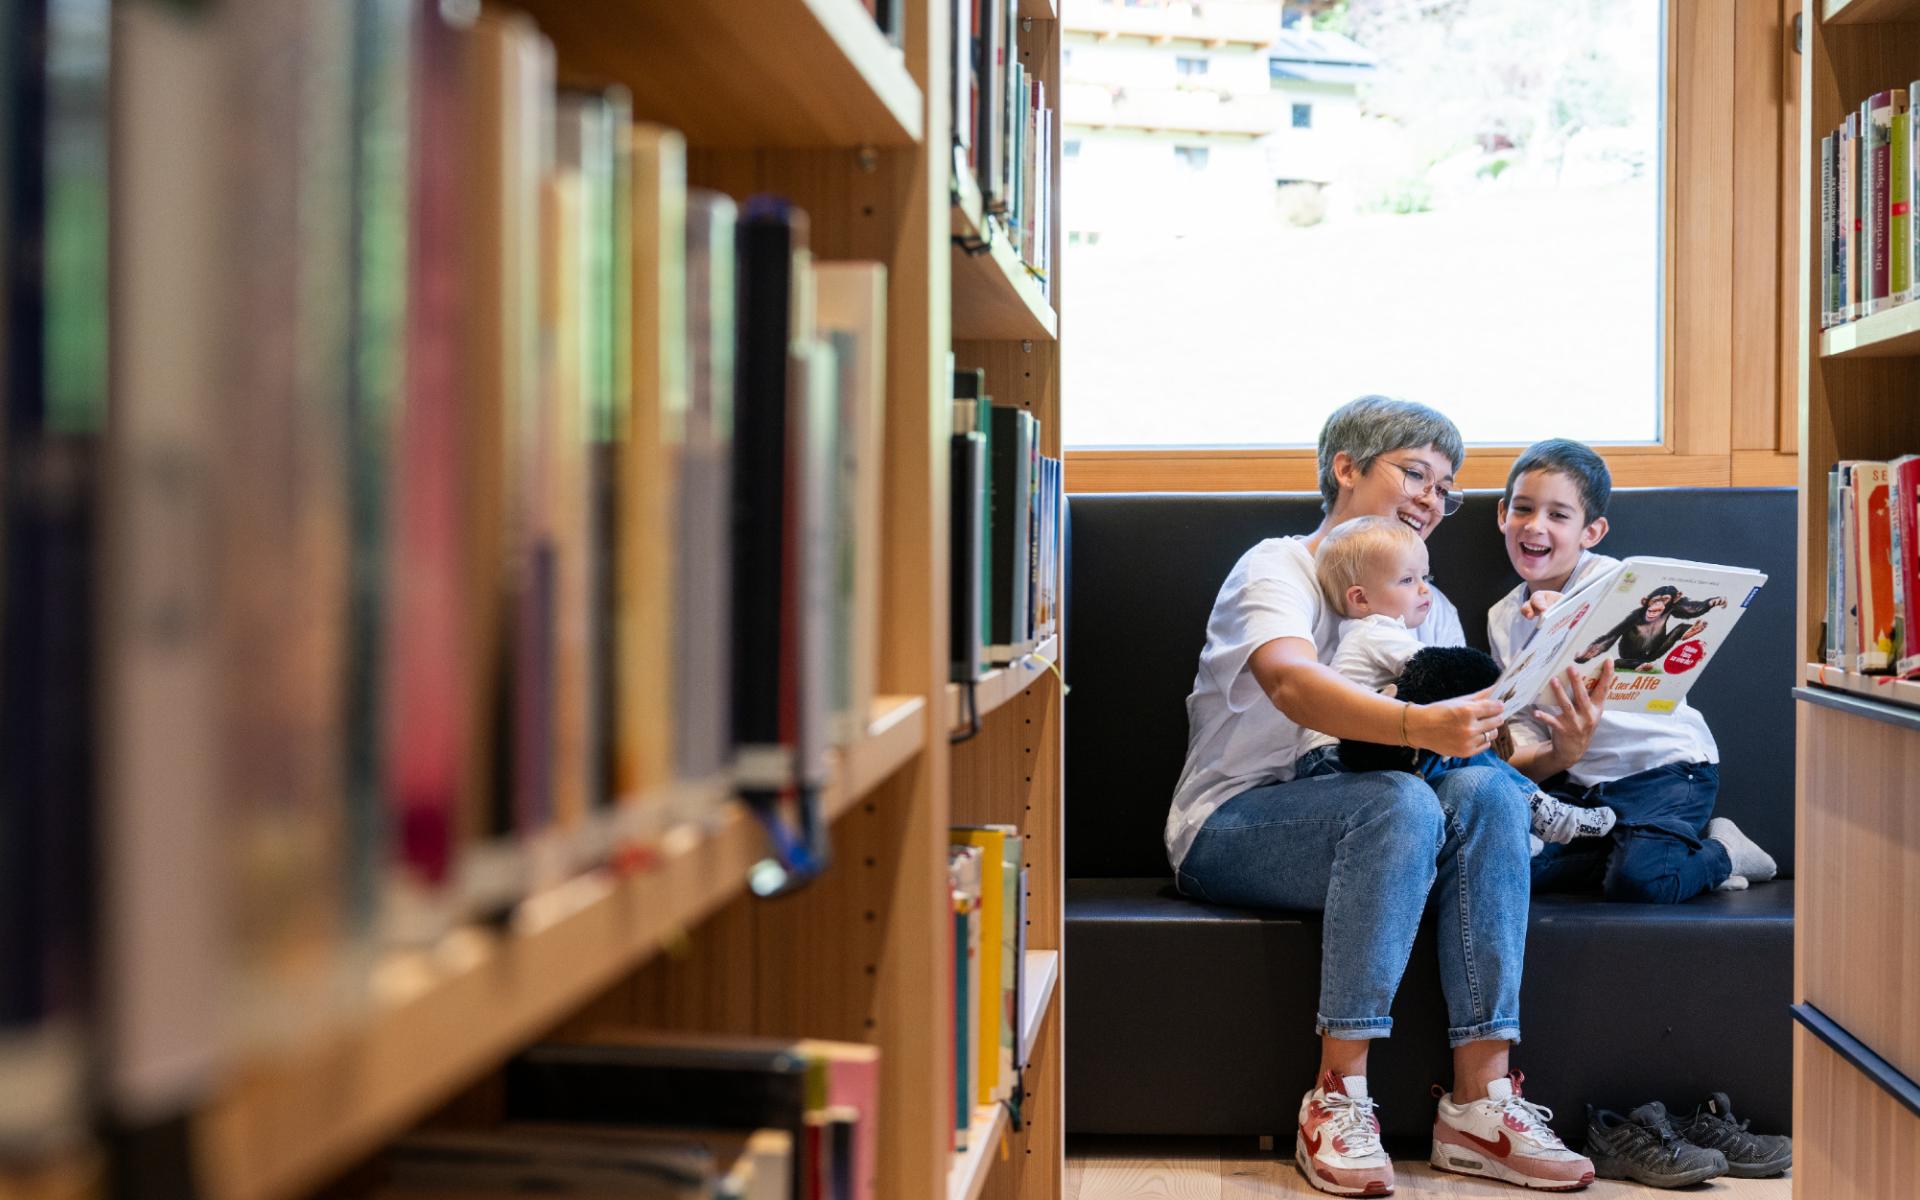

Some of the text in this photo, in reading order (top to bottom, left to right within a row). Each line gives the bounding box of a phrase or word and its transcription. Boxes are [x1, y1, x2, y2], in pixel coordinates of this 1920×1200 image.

[1875, 150, 1885, 271] Die verlorenen Spuren
[1616, 682, 1630, 690] der
[1629, 675, 1661, 690] Affe
